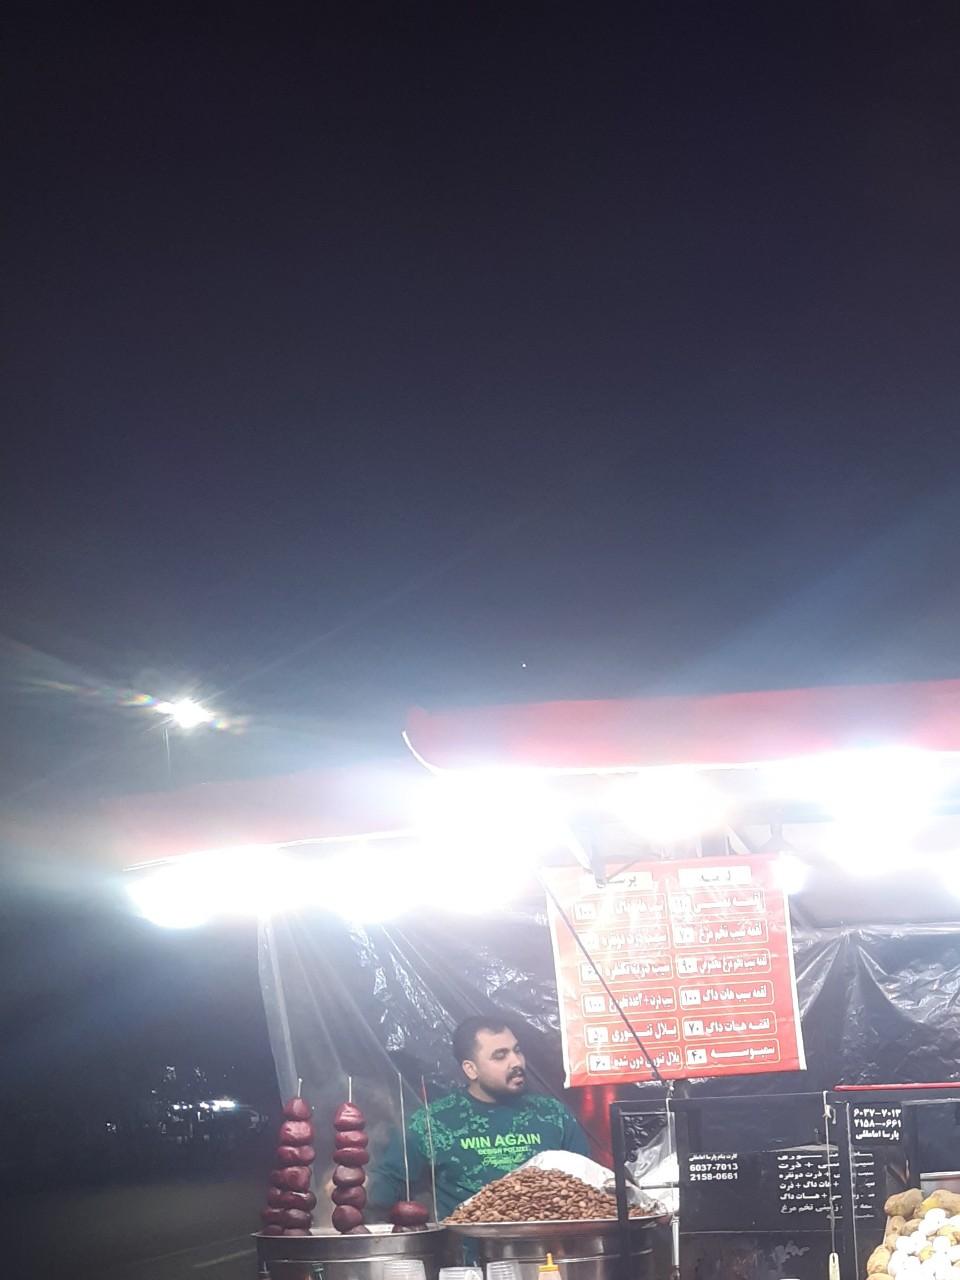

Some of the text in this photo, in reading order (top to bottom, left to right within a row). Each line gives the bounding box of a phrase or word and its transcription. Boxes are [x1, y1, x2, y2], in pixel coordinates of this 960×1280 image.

[735, 991, 752, 1002] سیب
[752, 984, 767, 998] لقمه
[654, 1022, 677, 1040] بلال
[710, 1046, 776, 1061] سمبوسه
[460, 1132, 542, 1150] WIN AGAIN
[689, 1163, 739, 1172] 6037-7013
[777, 1161, 802, 1171] ذرت
